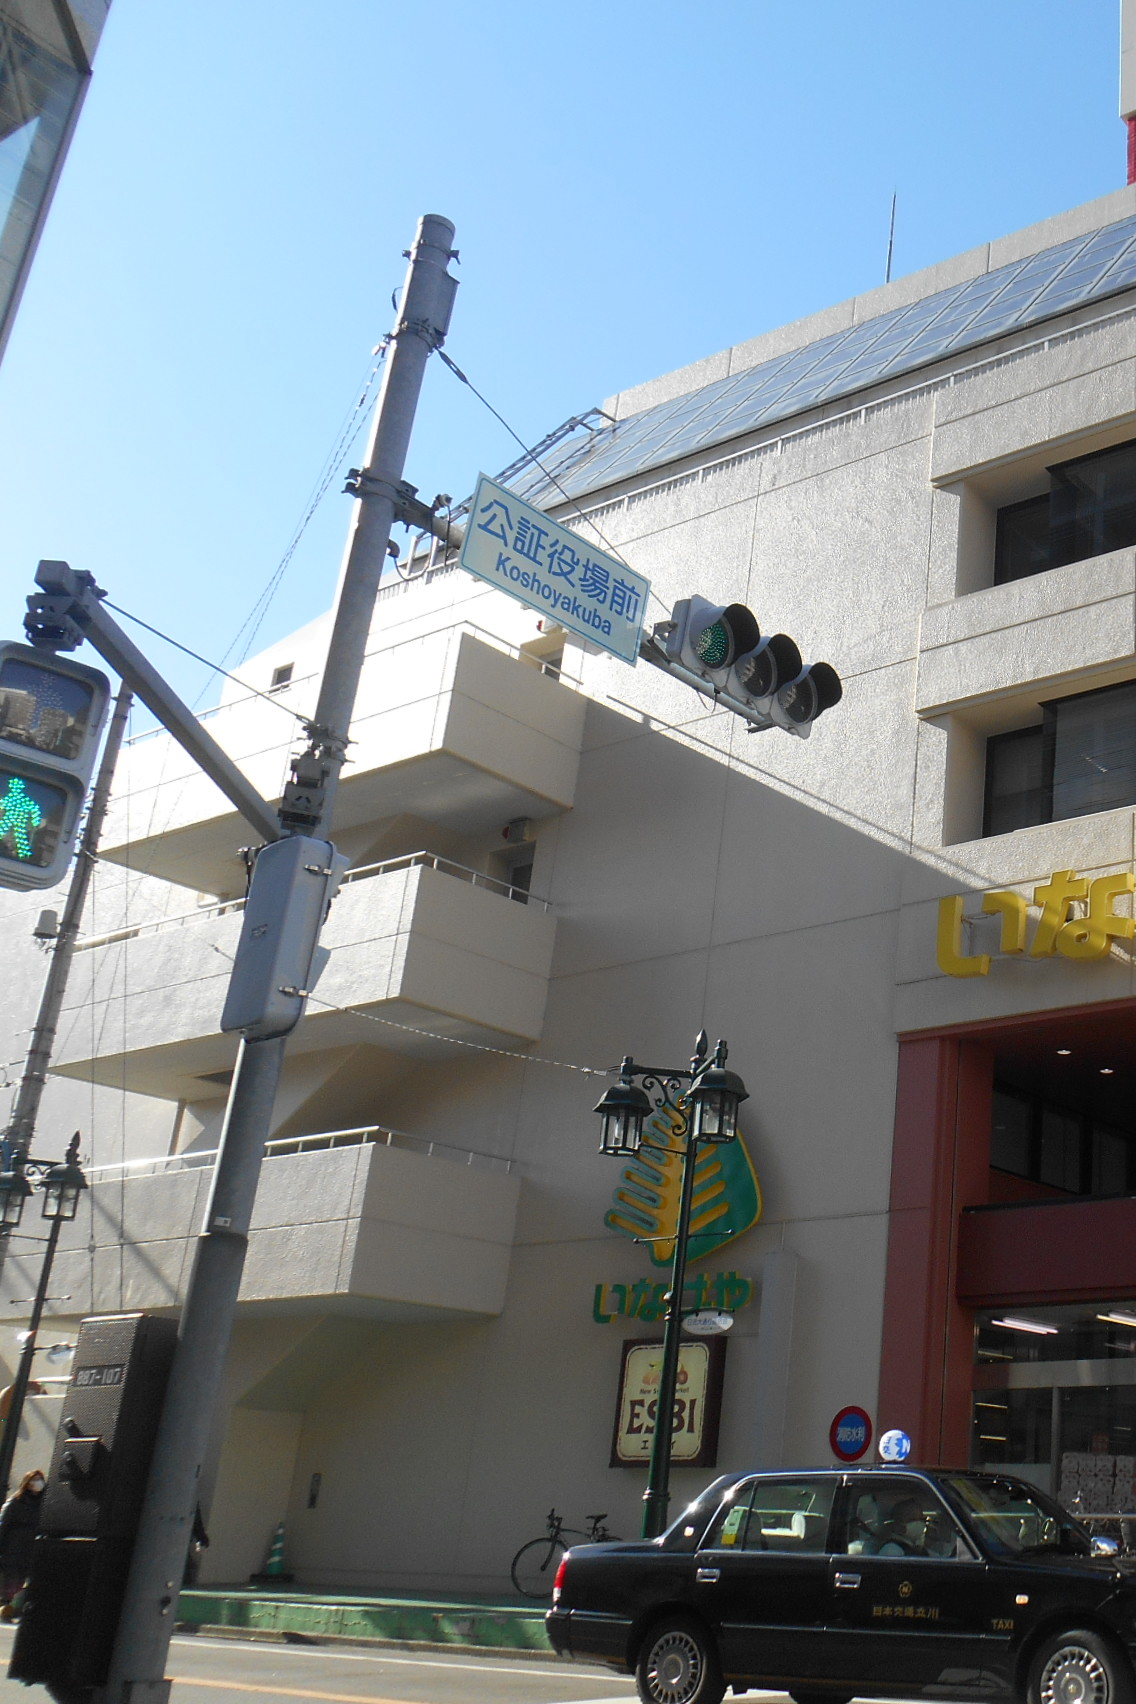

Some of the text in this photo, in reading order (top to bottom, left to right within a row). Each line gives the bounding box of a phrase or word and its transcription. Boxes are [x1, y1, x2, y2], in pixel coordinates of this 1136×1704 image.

[477, 499, 641, 624] 公証役場前
[495, 552, 612, 637] Koshoyakuba
[991, 1619, 1014, 1630] TAXI
